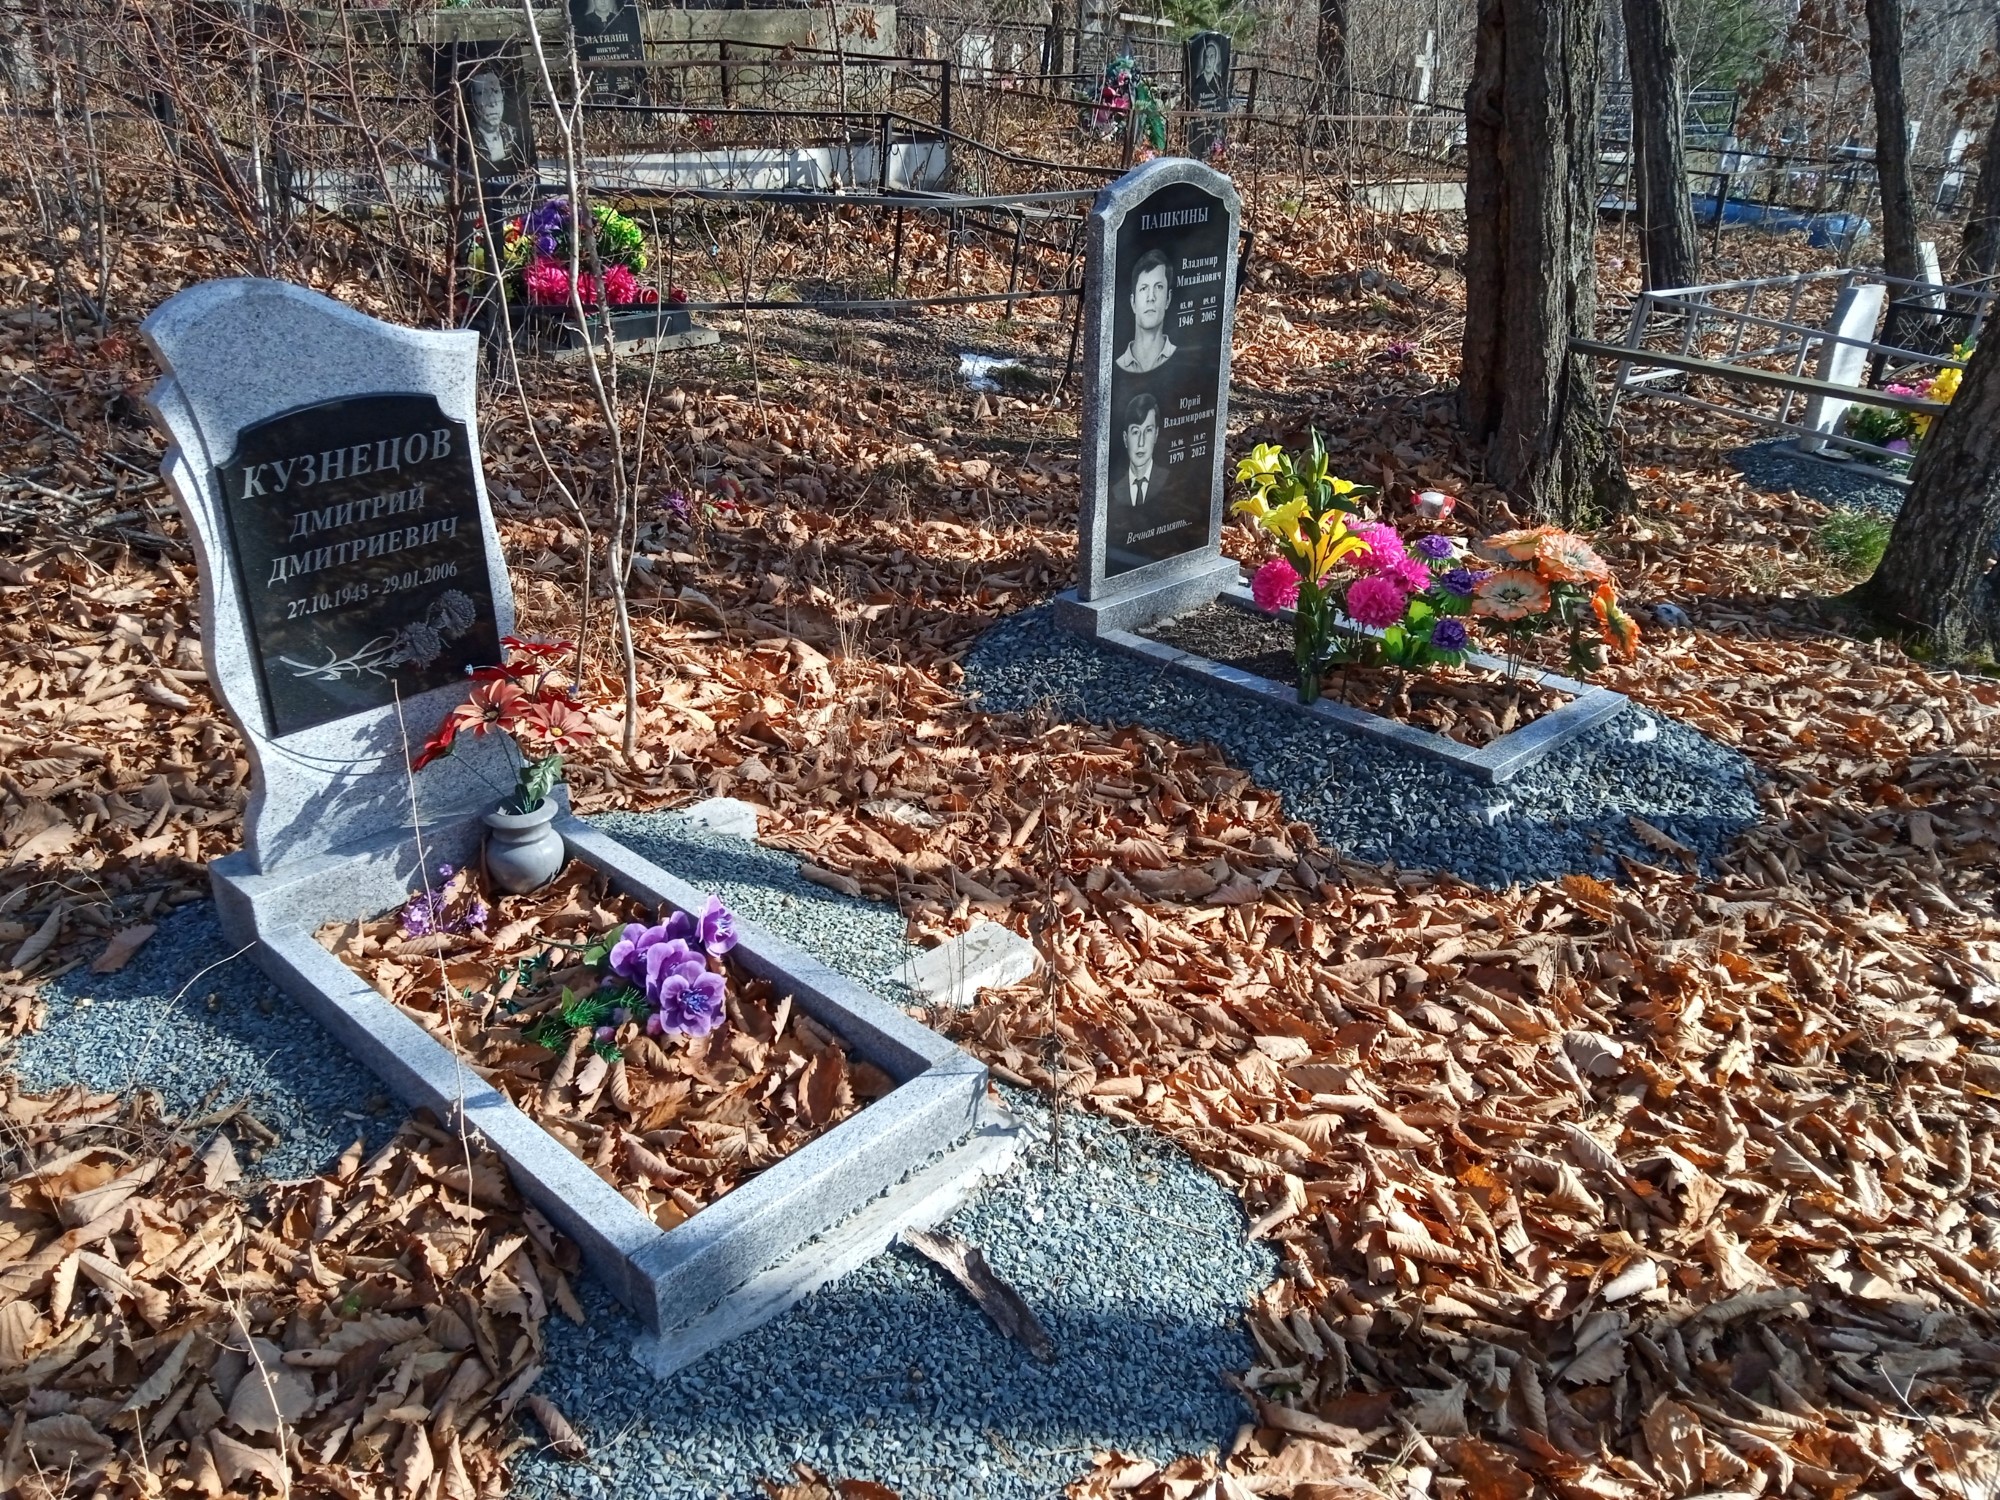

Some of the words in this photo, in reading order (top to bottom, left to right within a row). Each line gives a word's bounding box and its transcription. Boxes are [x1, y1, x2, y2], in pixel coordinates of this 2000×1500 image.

[1141, 207, 1208, 230] ПАШКИНЫ
[1182, 256, 1218, 270] Владимир
[1176, 271, 1222, 288] Михайлович
[1178, 315, 1194, 328] 1946
[1201, 310, 1217, 323] 2005
[1179, 395, 1201, 410] Юрий
[1163, 408, 1215, 429] Владимирович
[240, 428, 452, 500] КУЗНЕЦОВ
[1169, 451, 1185, 464] 1970
[1191, 445, 1206, 458] 2022
[289, 481, 427, 543] ДМИТРИЙ
[1126, 527, 1155, 545] Вечная
[267, 516, 459, 588] ДМИТРИЕВИЧ
[287, 582, 369, 620] 27.10.1943
[382, 561, 458, 595] 29.01.2006
